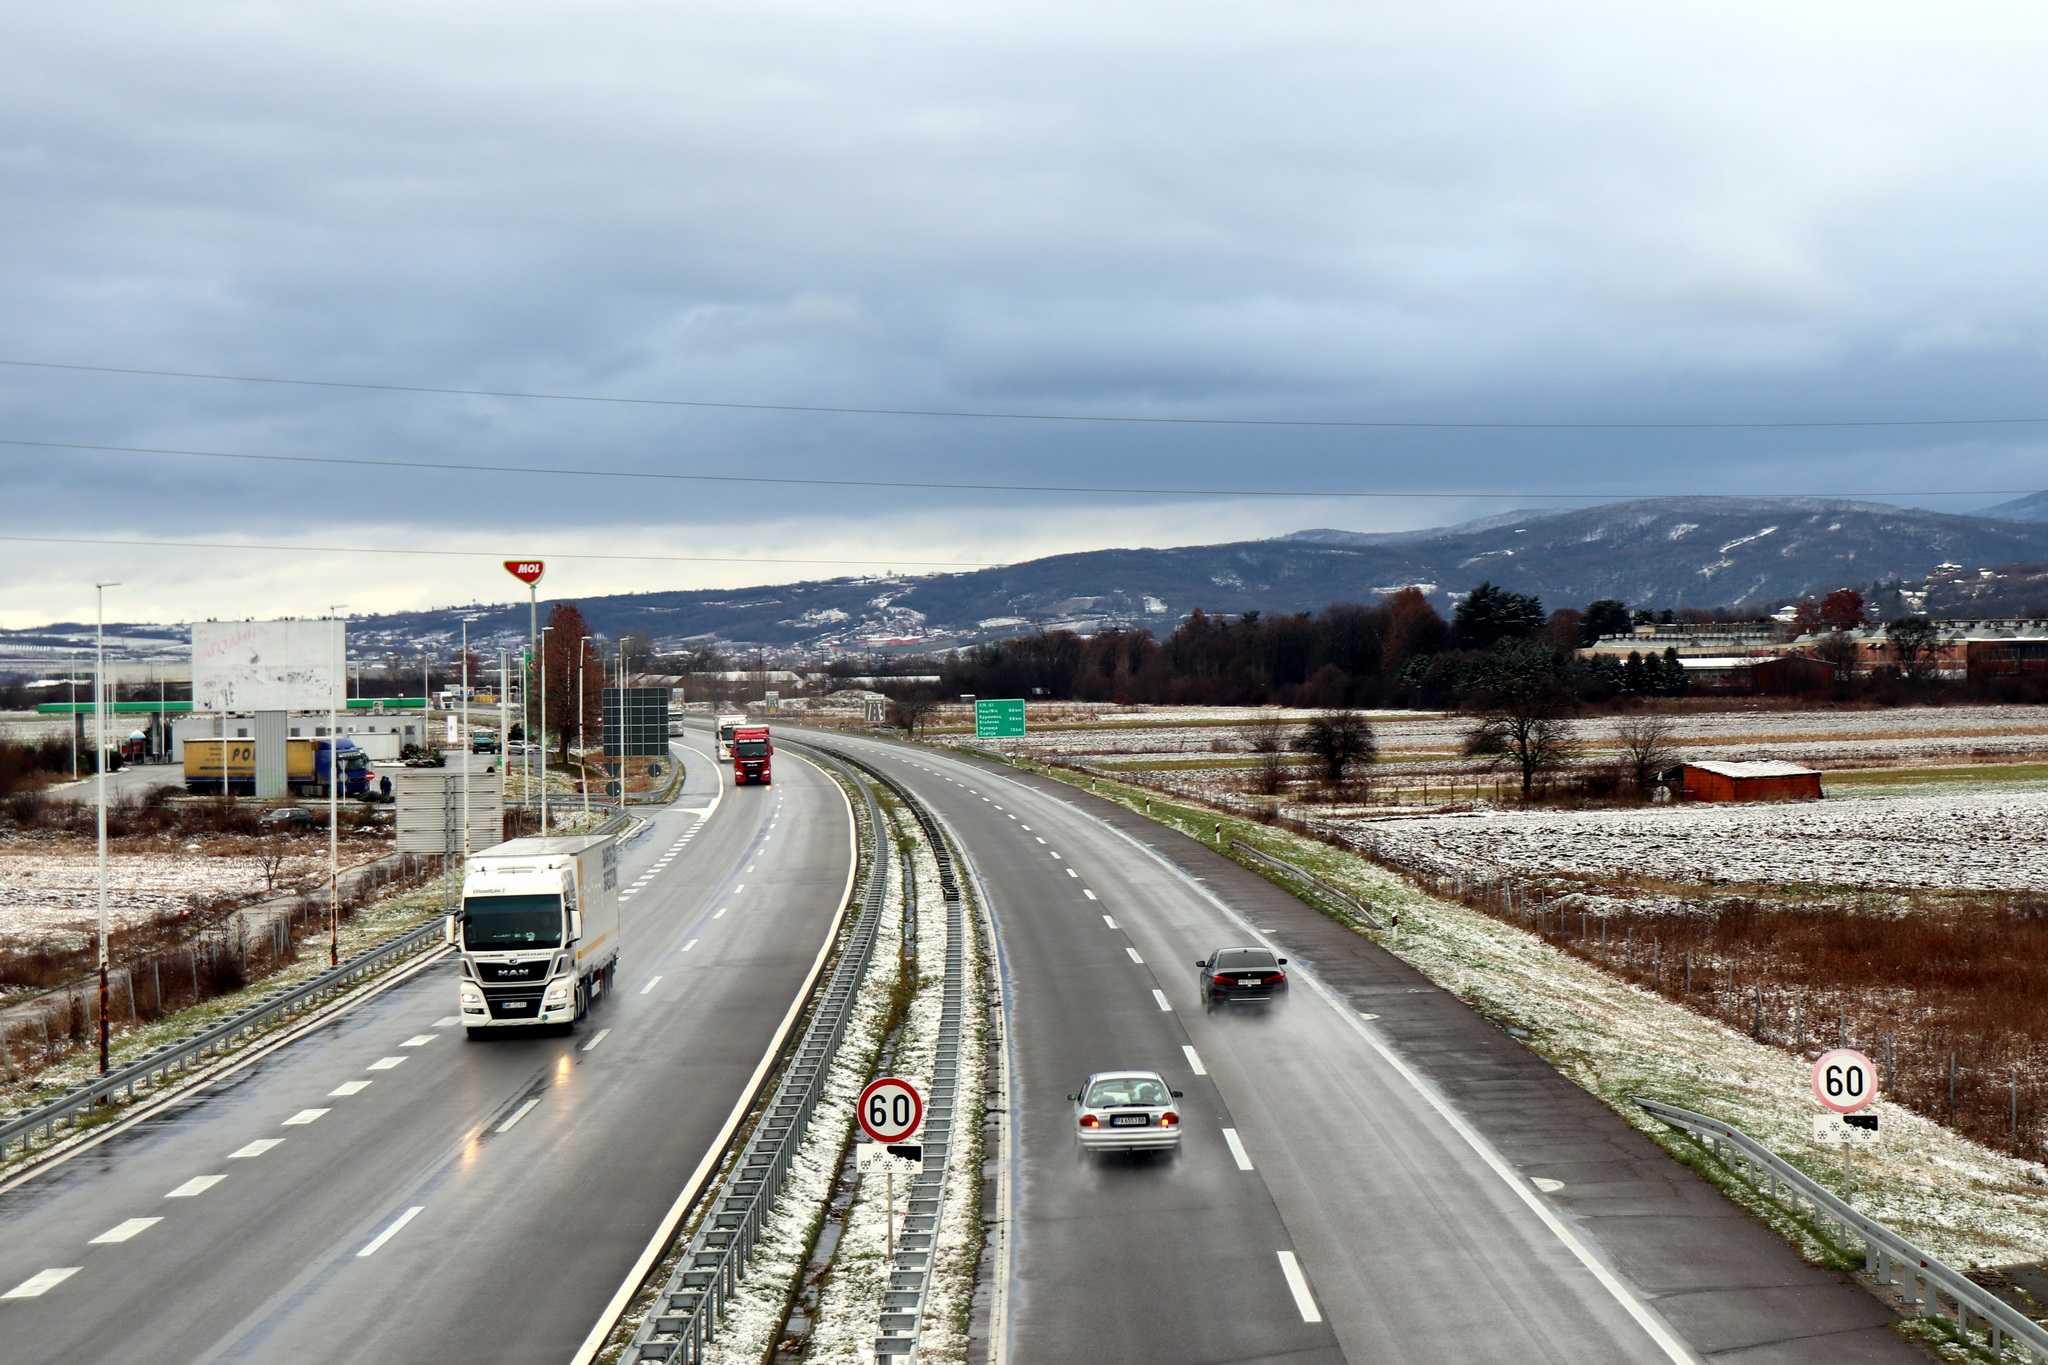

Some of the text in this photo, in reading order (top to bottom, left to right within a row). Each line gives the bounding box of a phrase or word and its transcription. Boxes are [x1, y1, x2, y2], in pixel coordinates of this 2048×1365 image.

[517, 564, 540, 573] MOL
[1826, 1065, 1863, 1097] 60
[870, 1094, 909, 1127] 60
